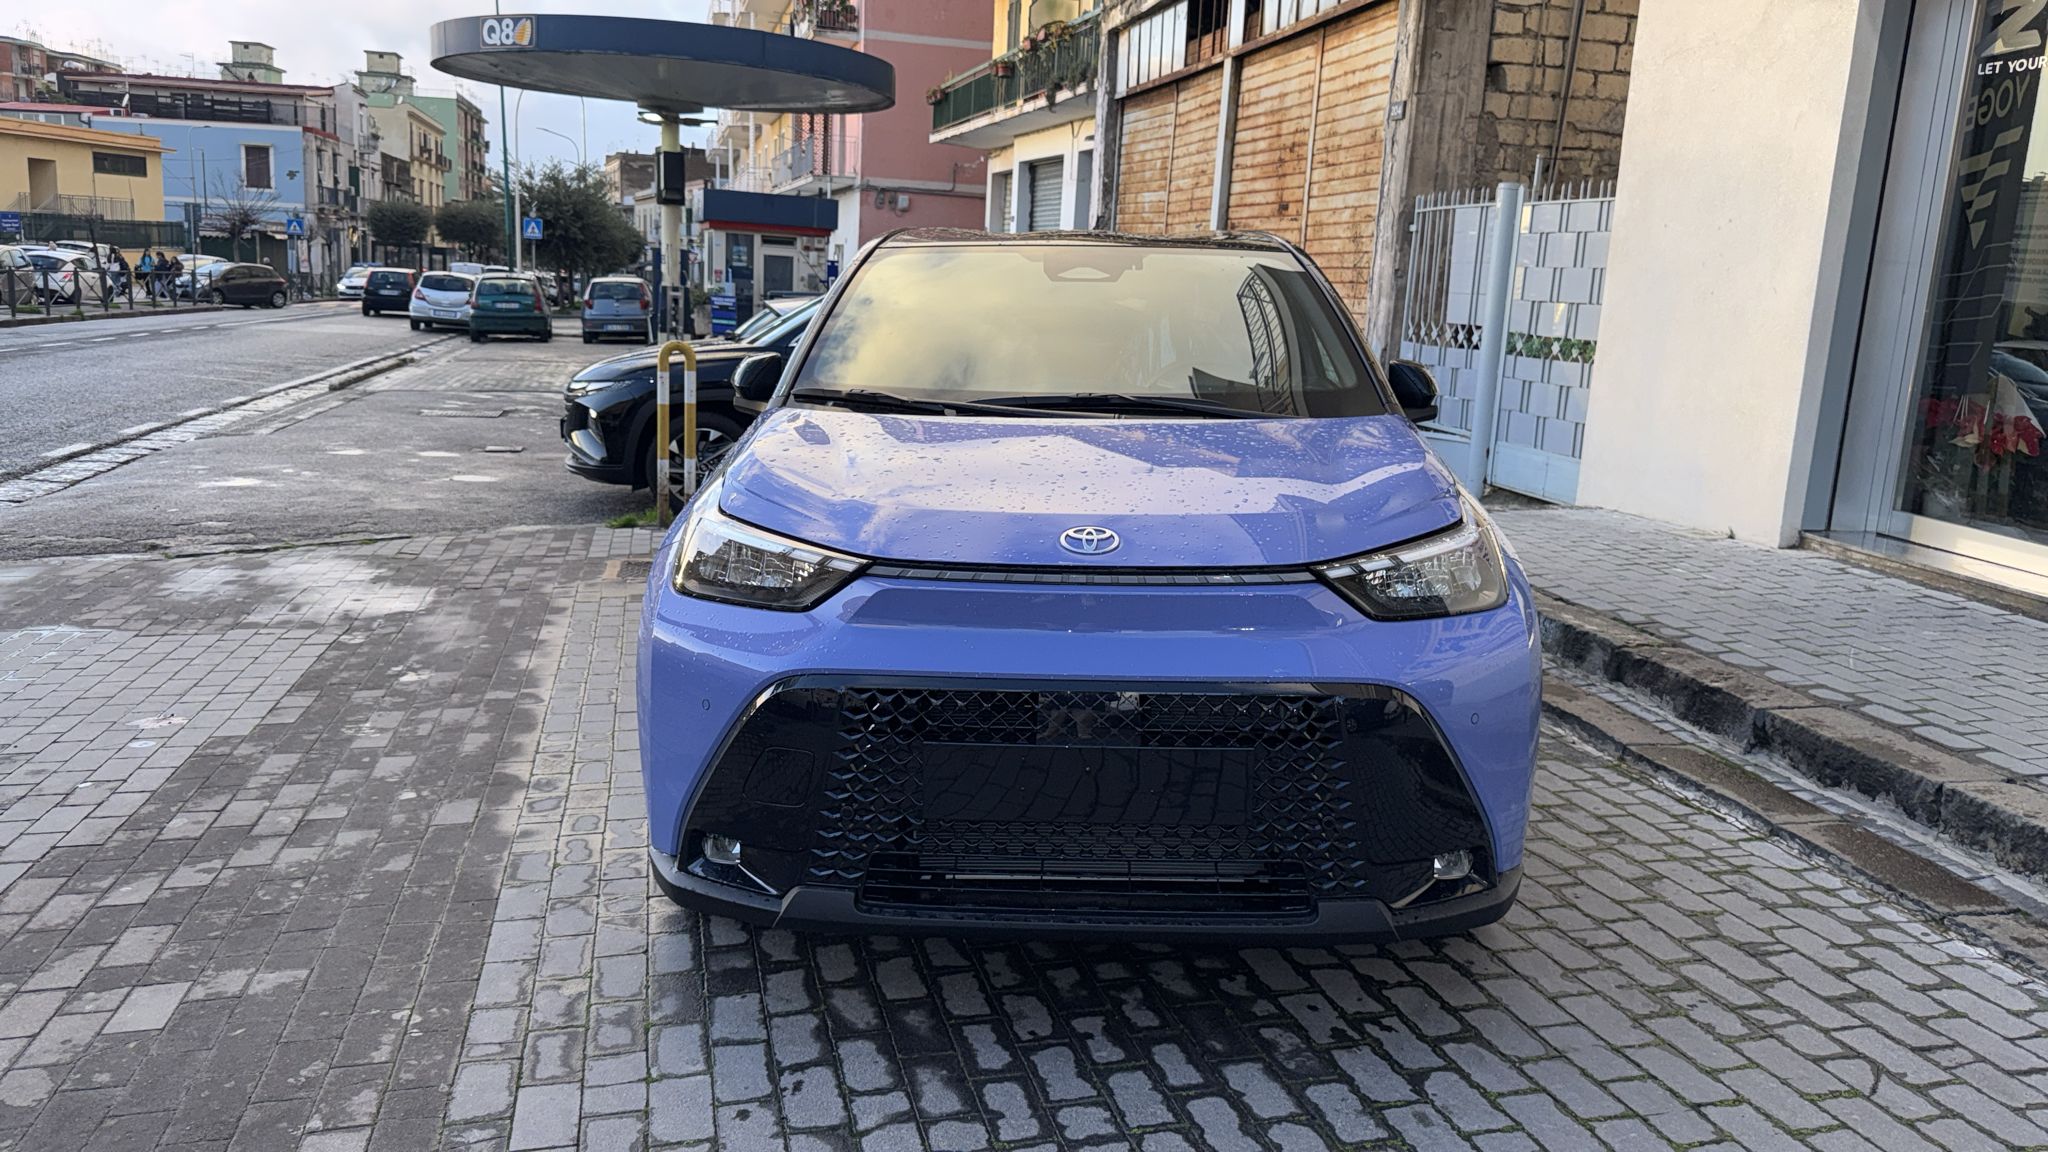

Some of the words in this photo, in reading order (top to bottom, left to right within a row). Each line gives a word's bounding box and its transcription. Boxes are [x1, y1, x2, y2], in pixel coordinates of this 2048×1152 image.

[483, 18, 514, 46] Q8
[1977, 61, 2004, 75] LET
[2008, 56, 2048, 73] YOUR
